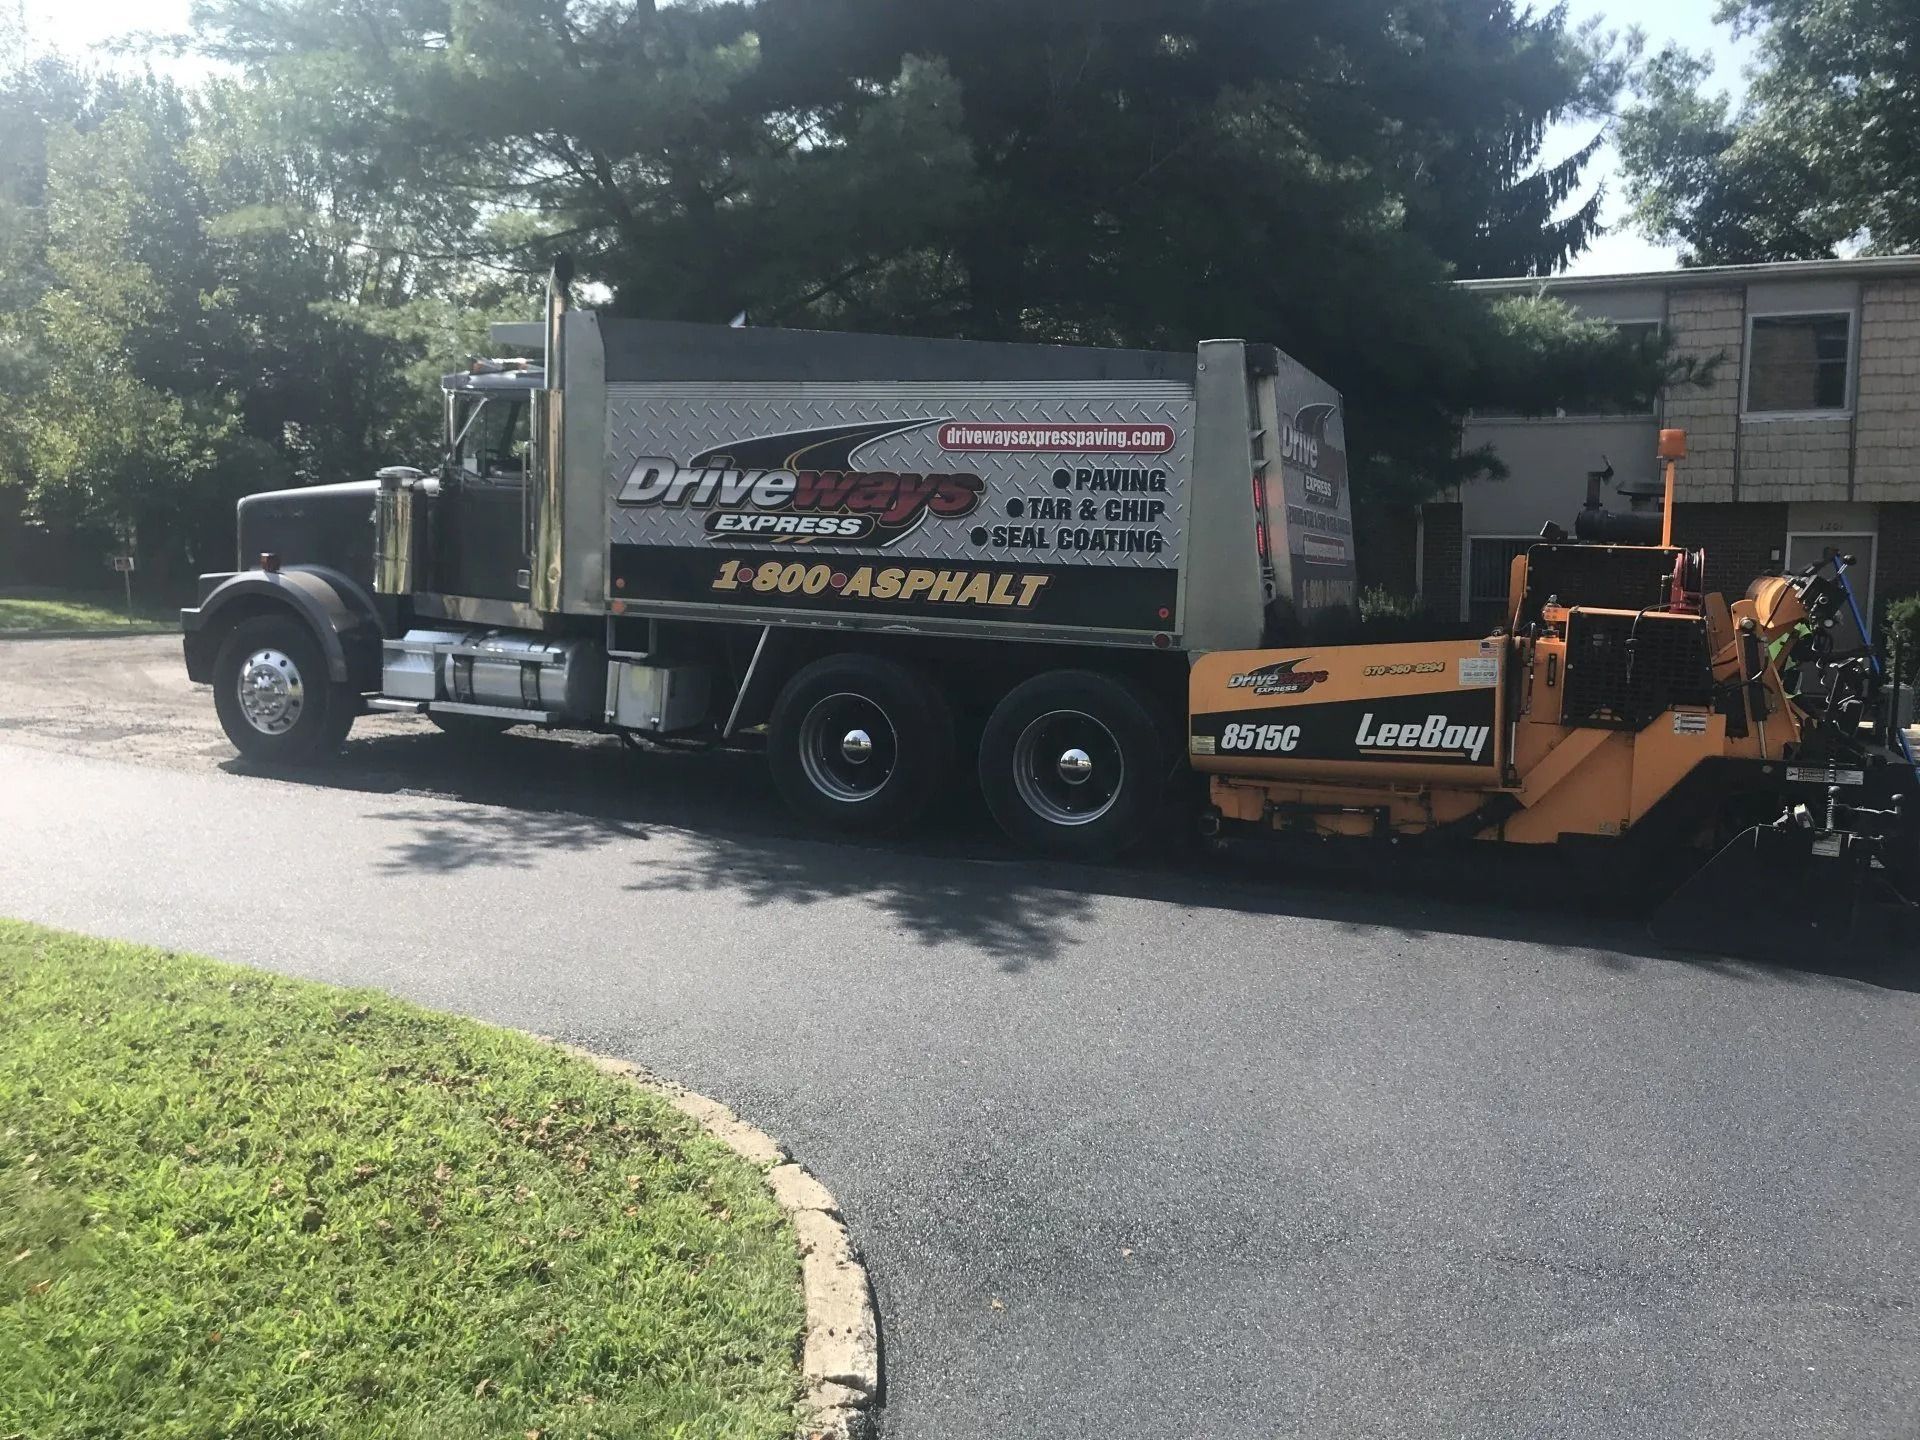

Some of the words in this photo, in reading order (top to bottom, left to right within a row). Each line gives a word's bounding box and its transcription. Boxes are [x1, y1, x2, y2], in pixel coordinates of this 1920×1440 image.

[946, 427, 1166, 448] drivewaysexpresspaving.com
[616, 454, 986, 528] Driveways
[1074, 467, 1167, 492] PAVING
[1305, 475, 1332, 497] EXPRESS
[1027, 496, 1073, 521] TAR
[1078, 498, 1098, 521] &
[1104, 497, 1166, 522] CHIP
[713, 514, 863, 536] EXPRESS
[991, 525, 1050, 549] SEAL
[1056, 527, 1163, 553] COATING
[1256, 684, 1299, 694] EXPRESS
[1220, 722, 1301, 752] 8515C
[1355, 713, 1491, 762] LeeBoy
